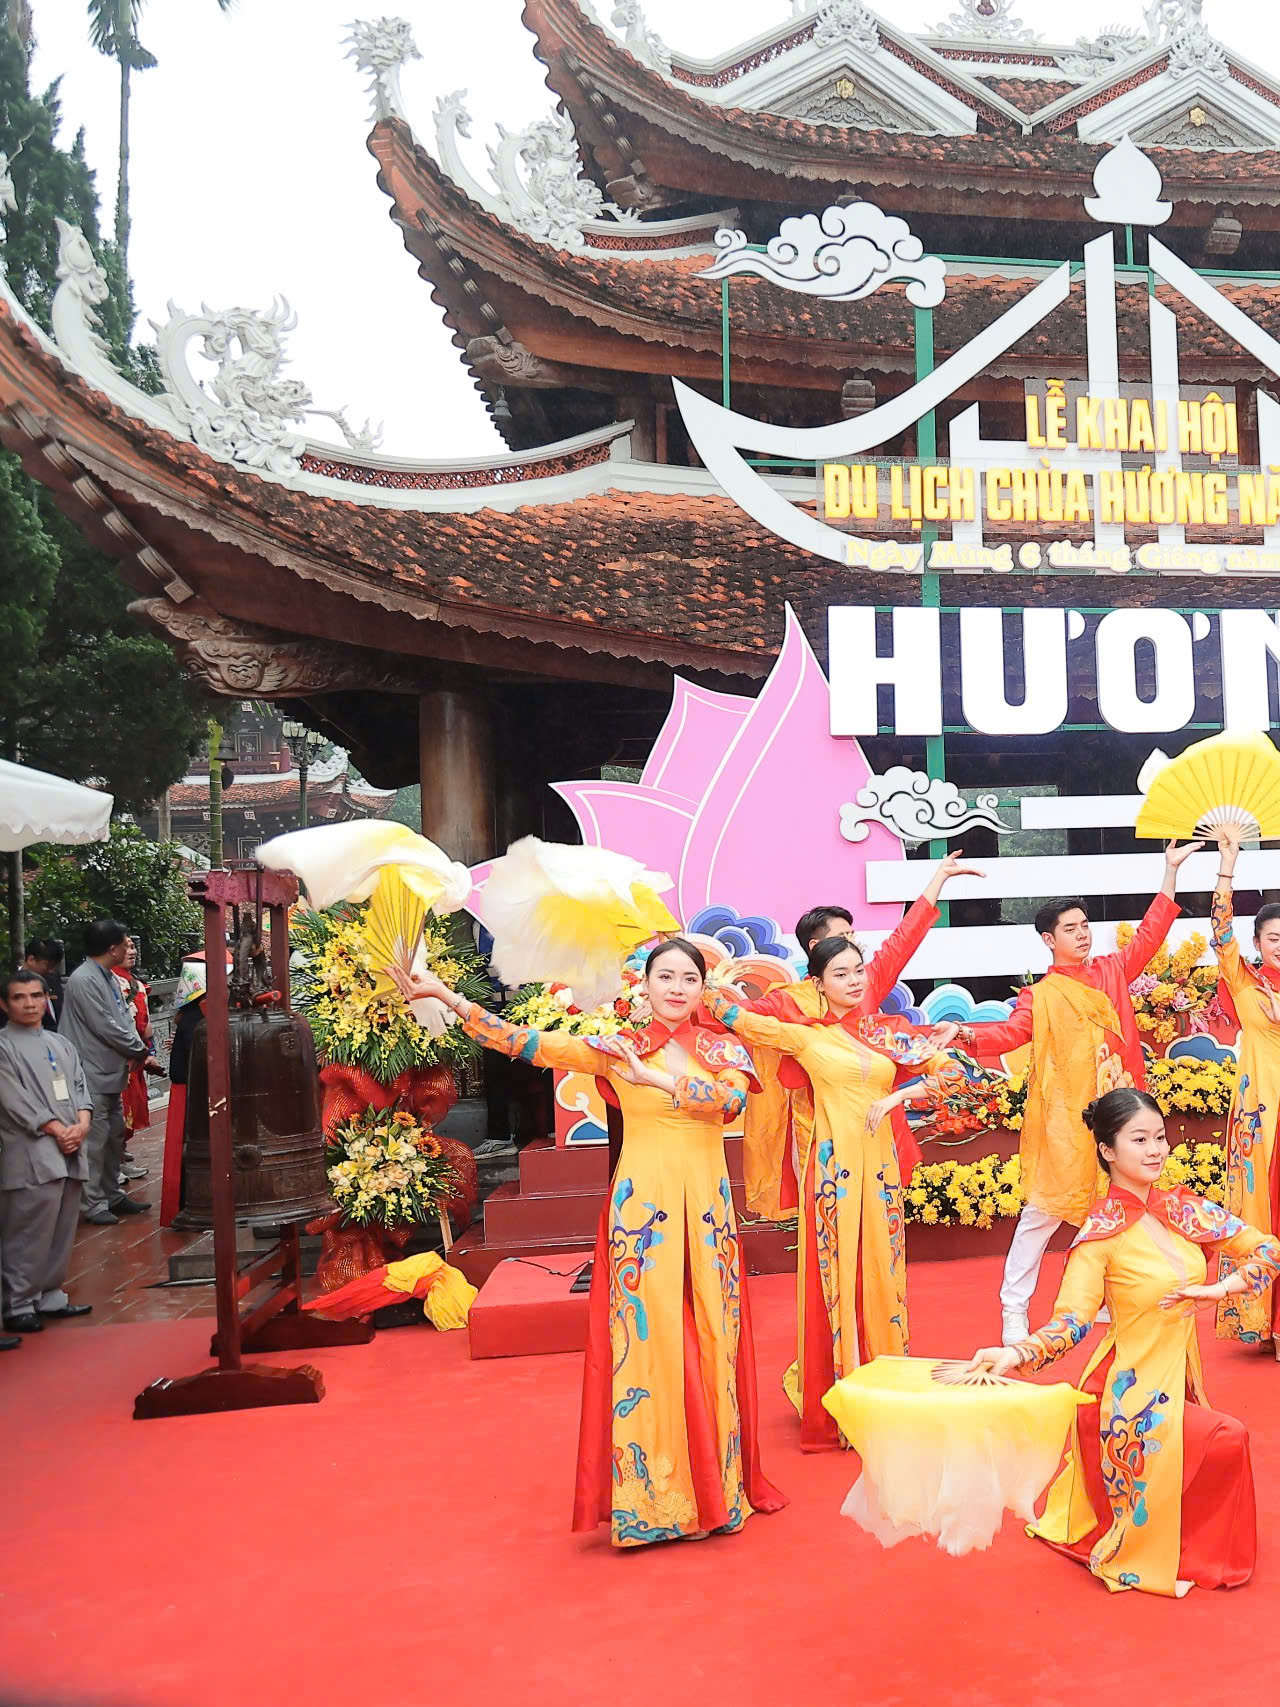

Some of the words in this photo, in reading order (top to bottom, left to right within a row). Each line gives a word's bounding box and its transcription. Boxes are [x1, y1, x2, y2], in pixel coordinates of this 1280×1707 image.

[1026, 379, 1068, 450] LỄ
[1076, 396, 1169, 453] KHAI
[1177, 391, 1239, 465] HỘI
[823, 463, 879, 520] DU
[890, 464, 976, 530] LỊCH
[985, 456, 1092, 523] CHÙA
[1099, 464, 1229, 526] HƯƠNG
[847, 540, 922, 570] Ngày
[1019, 542, 1042, 569] 6
[1047, 540, 1132, 573] tháng
[1137, 543, 1221, 575] Giêng
